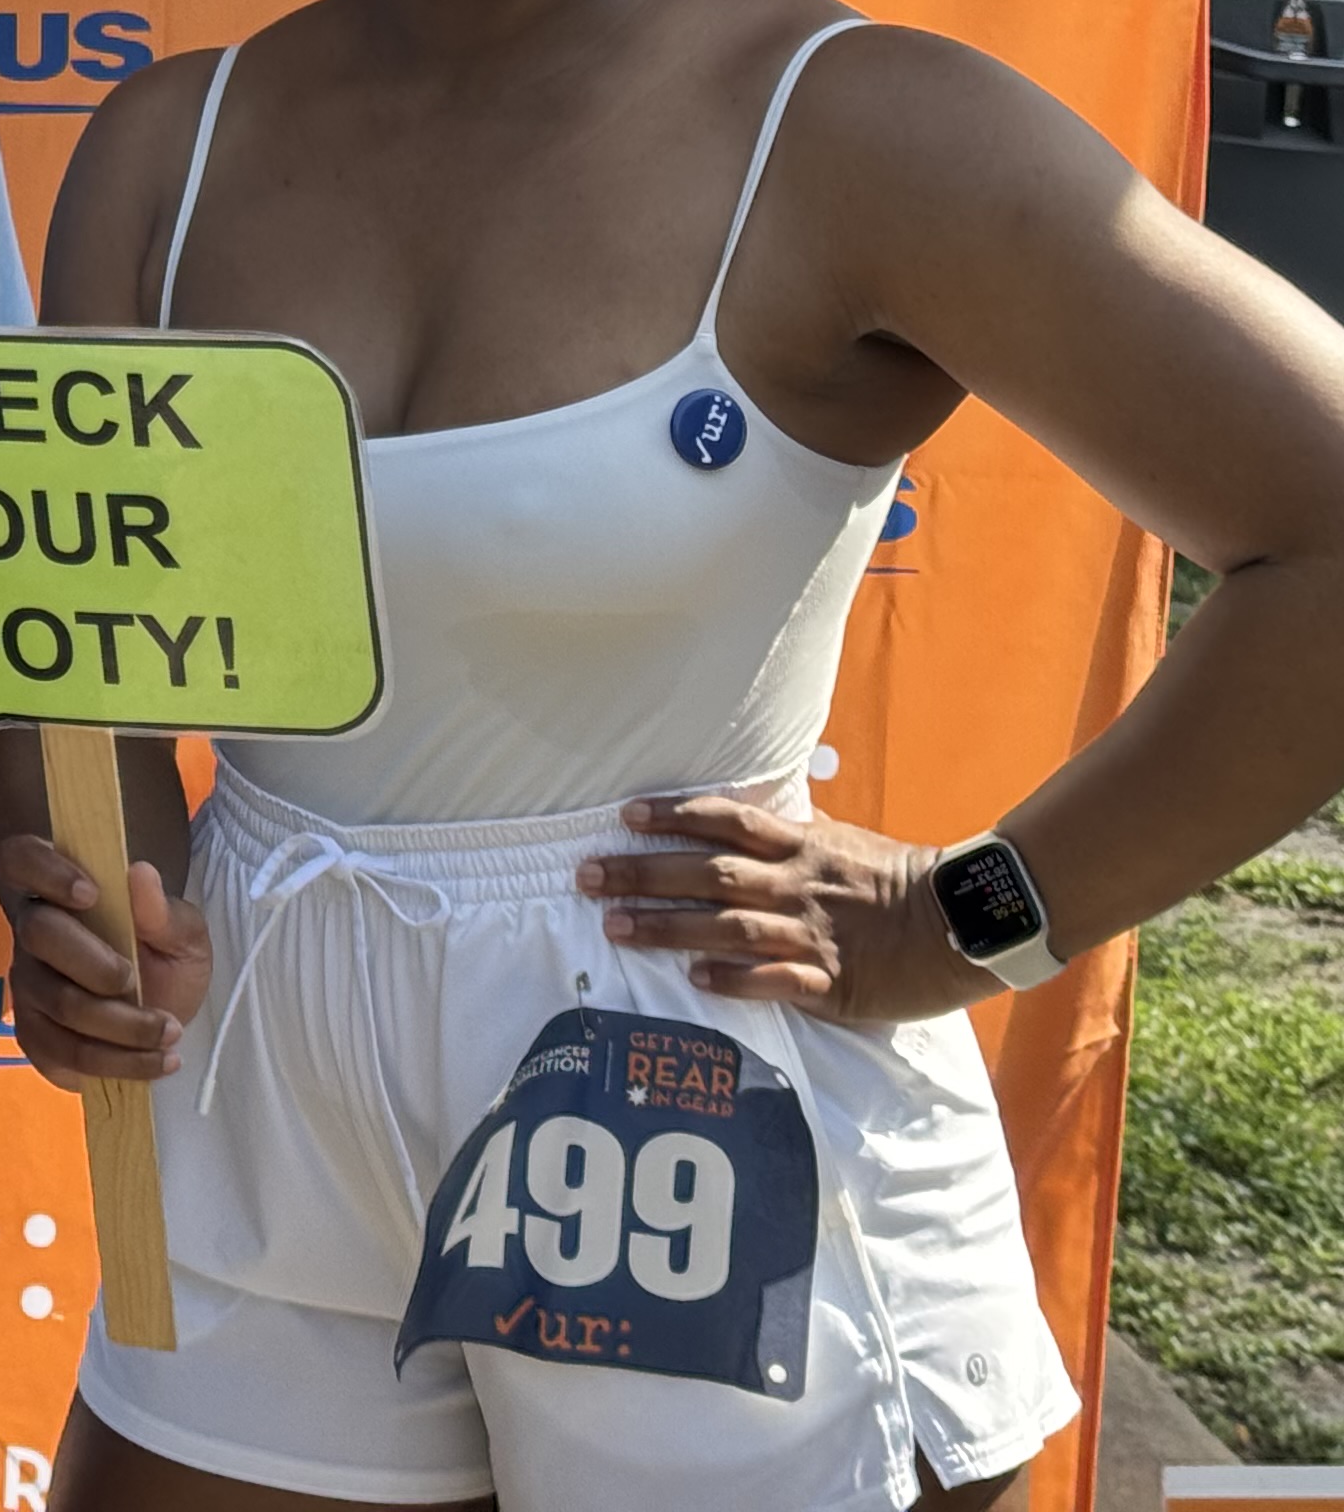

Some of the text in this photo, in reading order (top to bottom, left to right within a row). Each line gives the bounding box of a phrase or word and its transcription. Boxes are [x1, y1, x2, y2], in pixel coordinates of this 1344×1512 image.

[630, 1032, 734, 1064] GET YOUR
[627, 1051, 734, 1098] REAR
[650, 1090, 734, 1118] IN GEAR
[441, 1116, 735, 1301] 499
